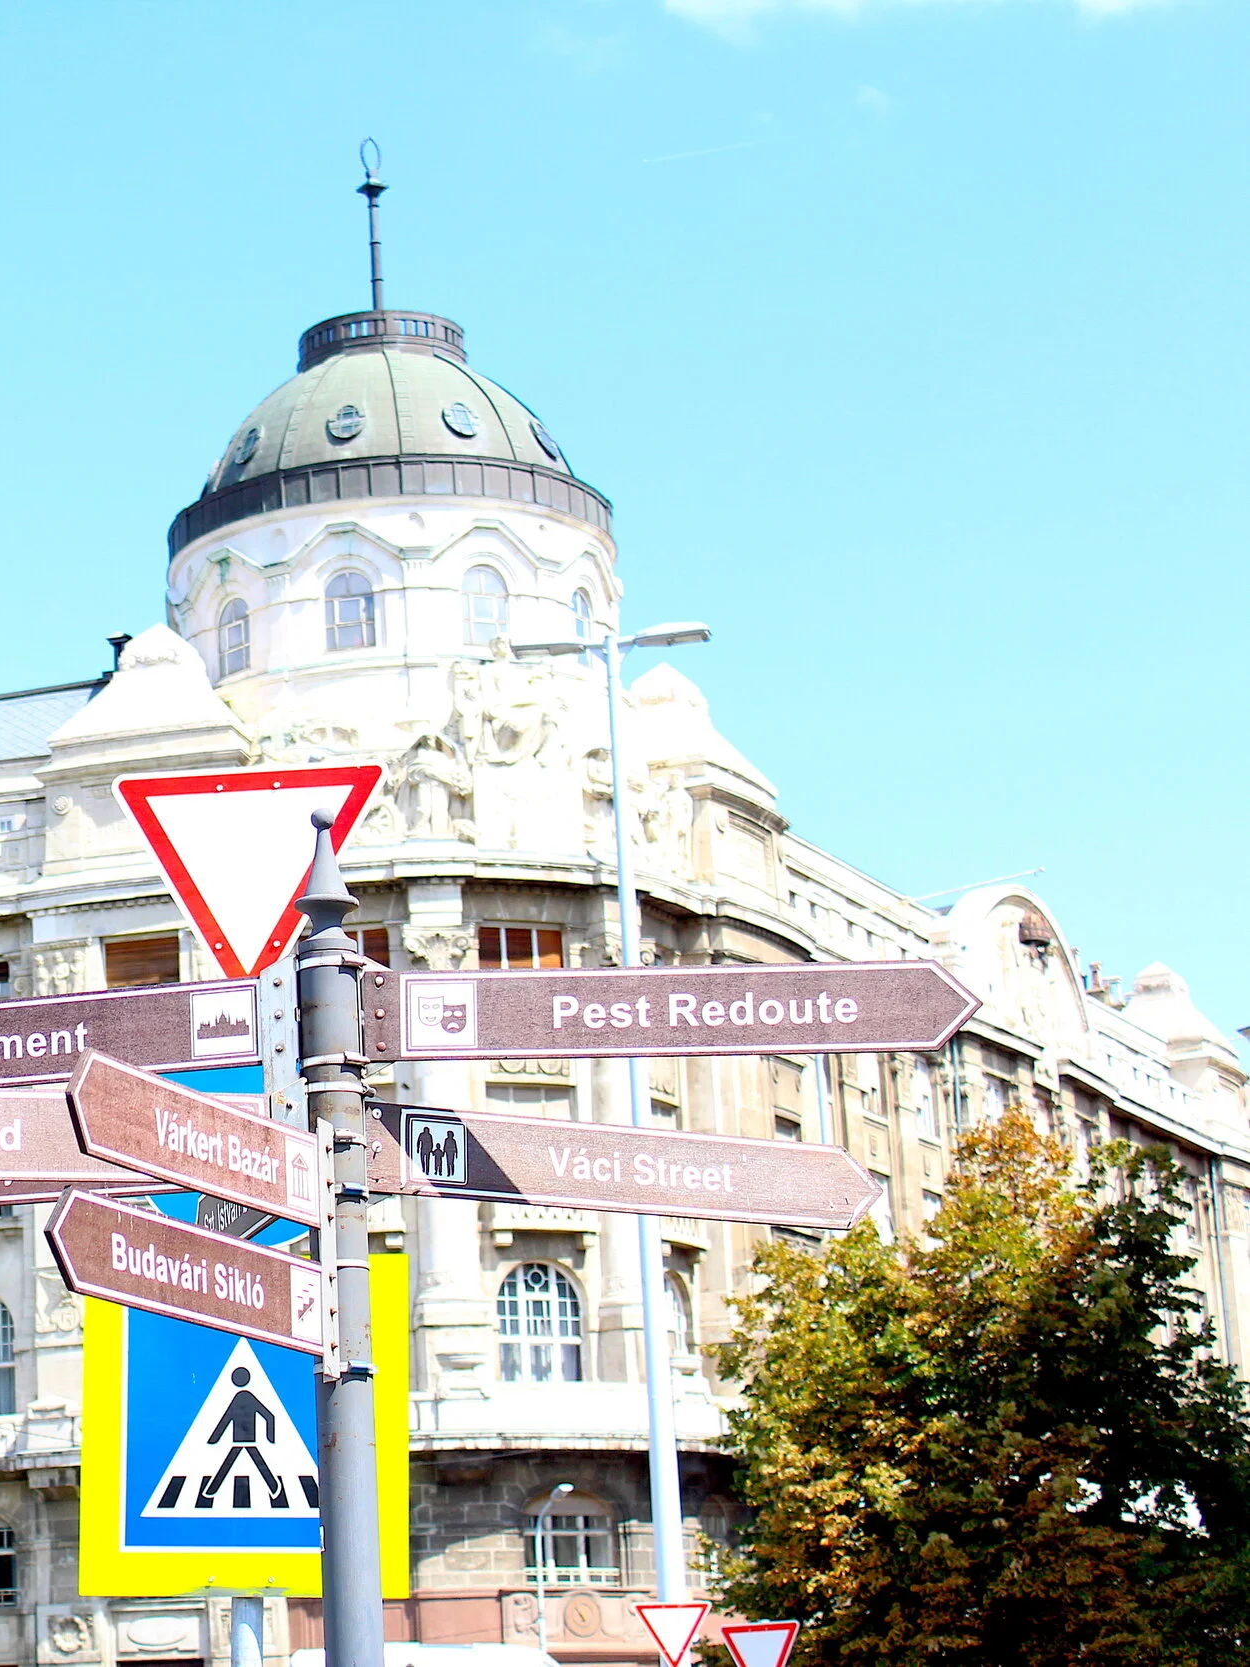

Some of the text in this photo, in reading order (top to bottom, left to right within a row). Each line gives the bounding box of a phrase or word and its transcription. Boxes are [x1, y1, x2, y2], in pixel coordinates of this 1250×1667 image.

[552, 991, 858, 1029] Pest Redoute
[155, 1107, 280, 1184] Várkert Bazár
[548, 1146, 734, 1193] Váci Street
[111, 1232, 265, 1310] Budavári Sikló
